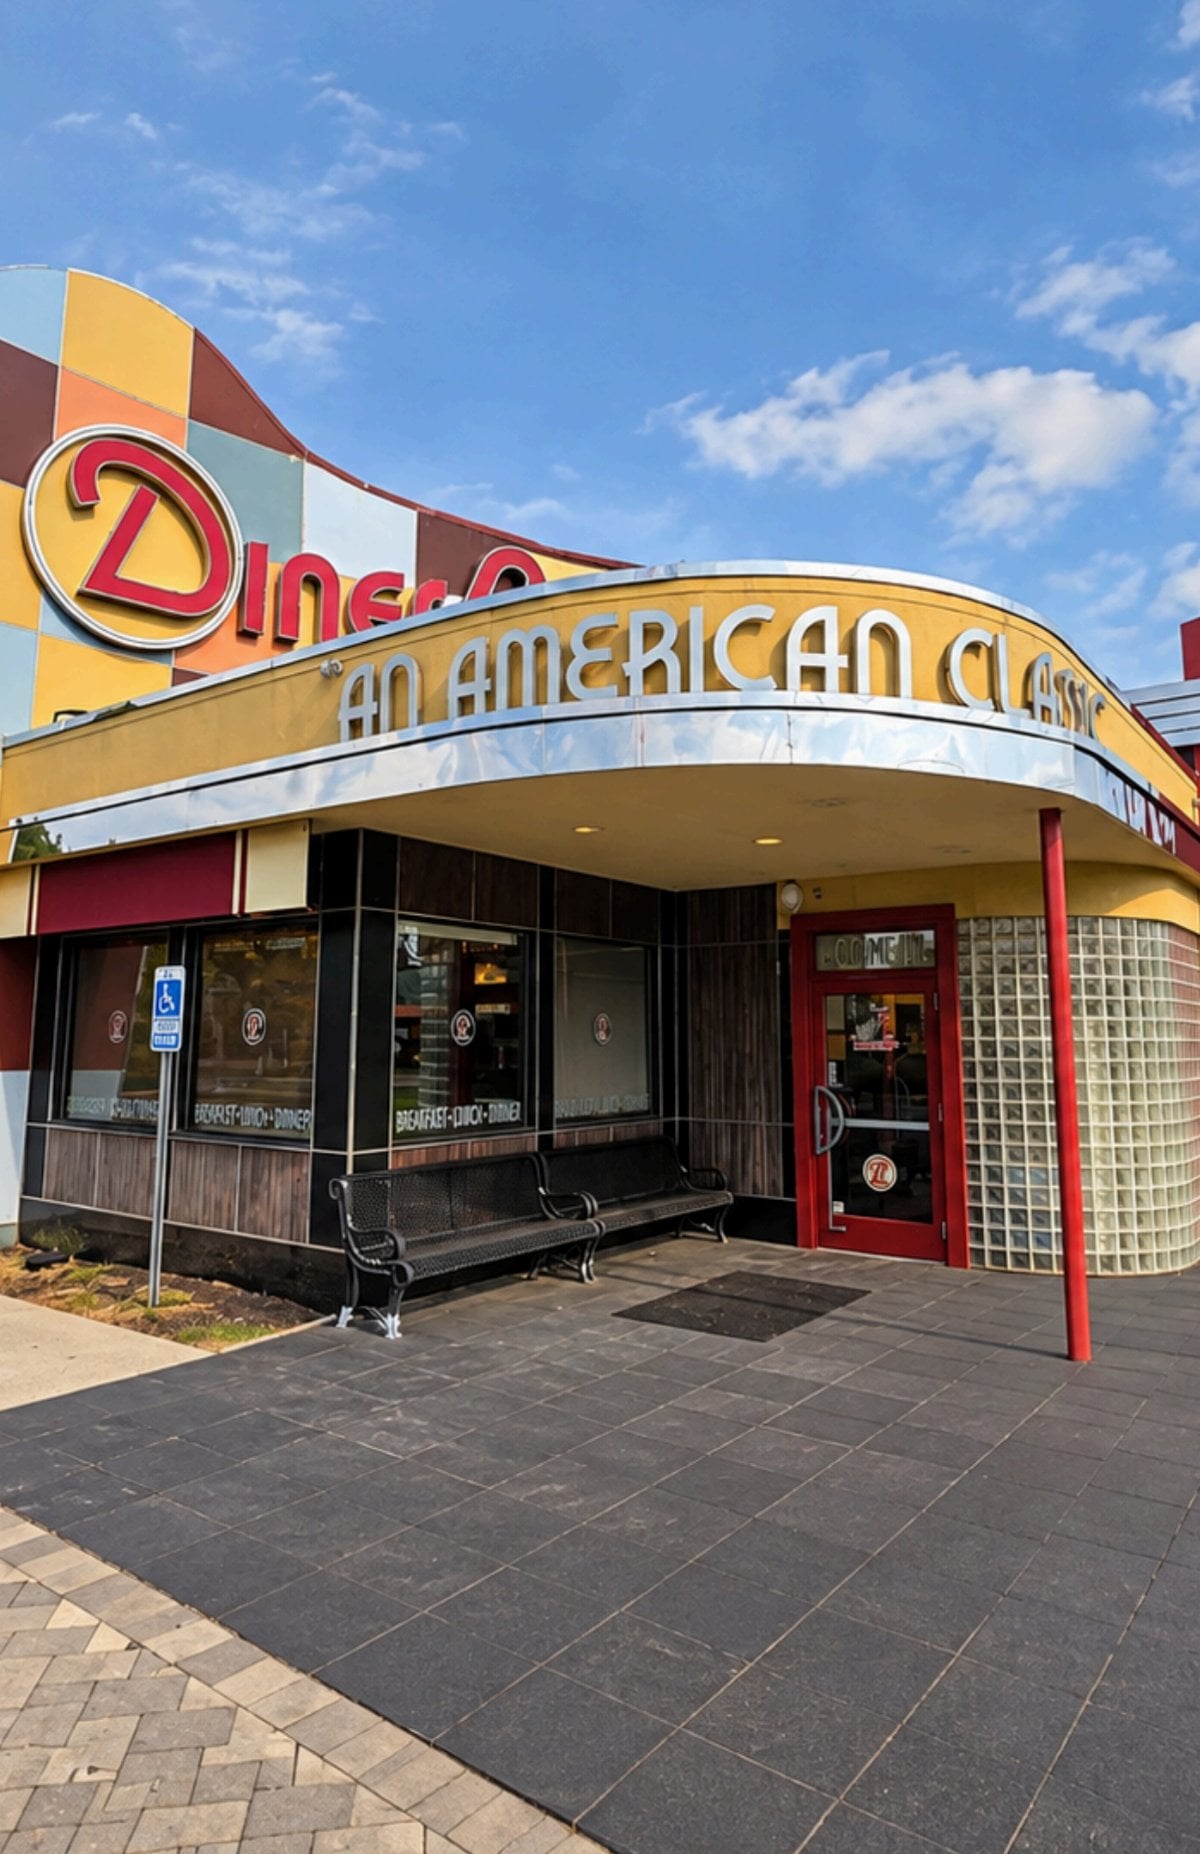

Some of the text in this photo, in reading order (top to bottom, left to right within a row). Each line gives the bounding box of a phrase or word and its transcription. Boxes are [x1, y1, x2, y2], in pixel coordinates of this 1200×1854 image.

[337, 604, 1107, 743] AN AMERICAN CLASSIC
